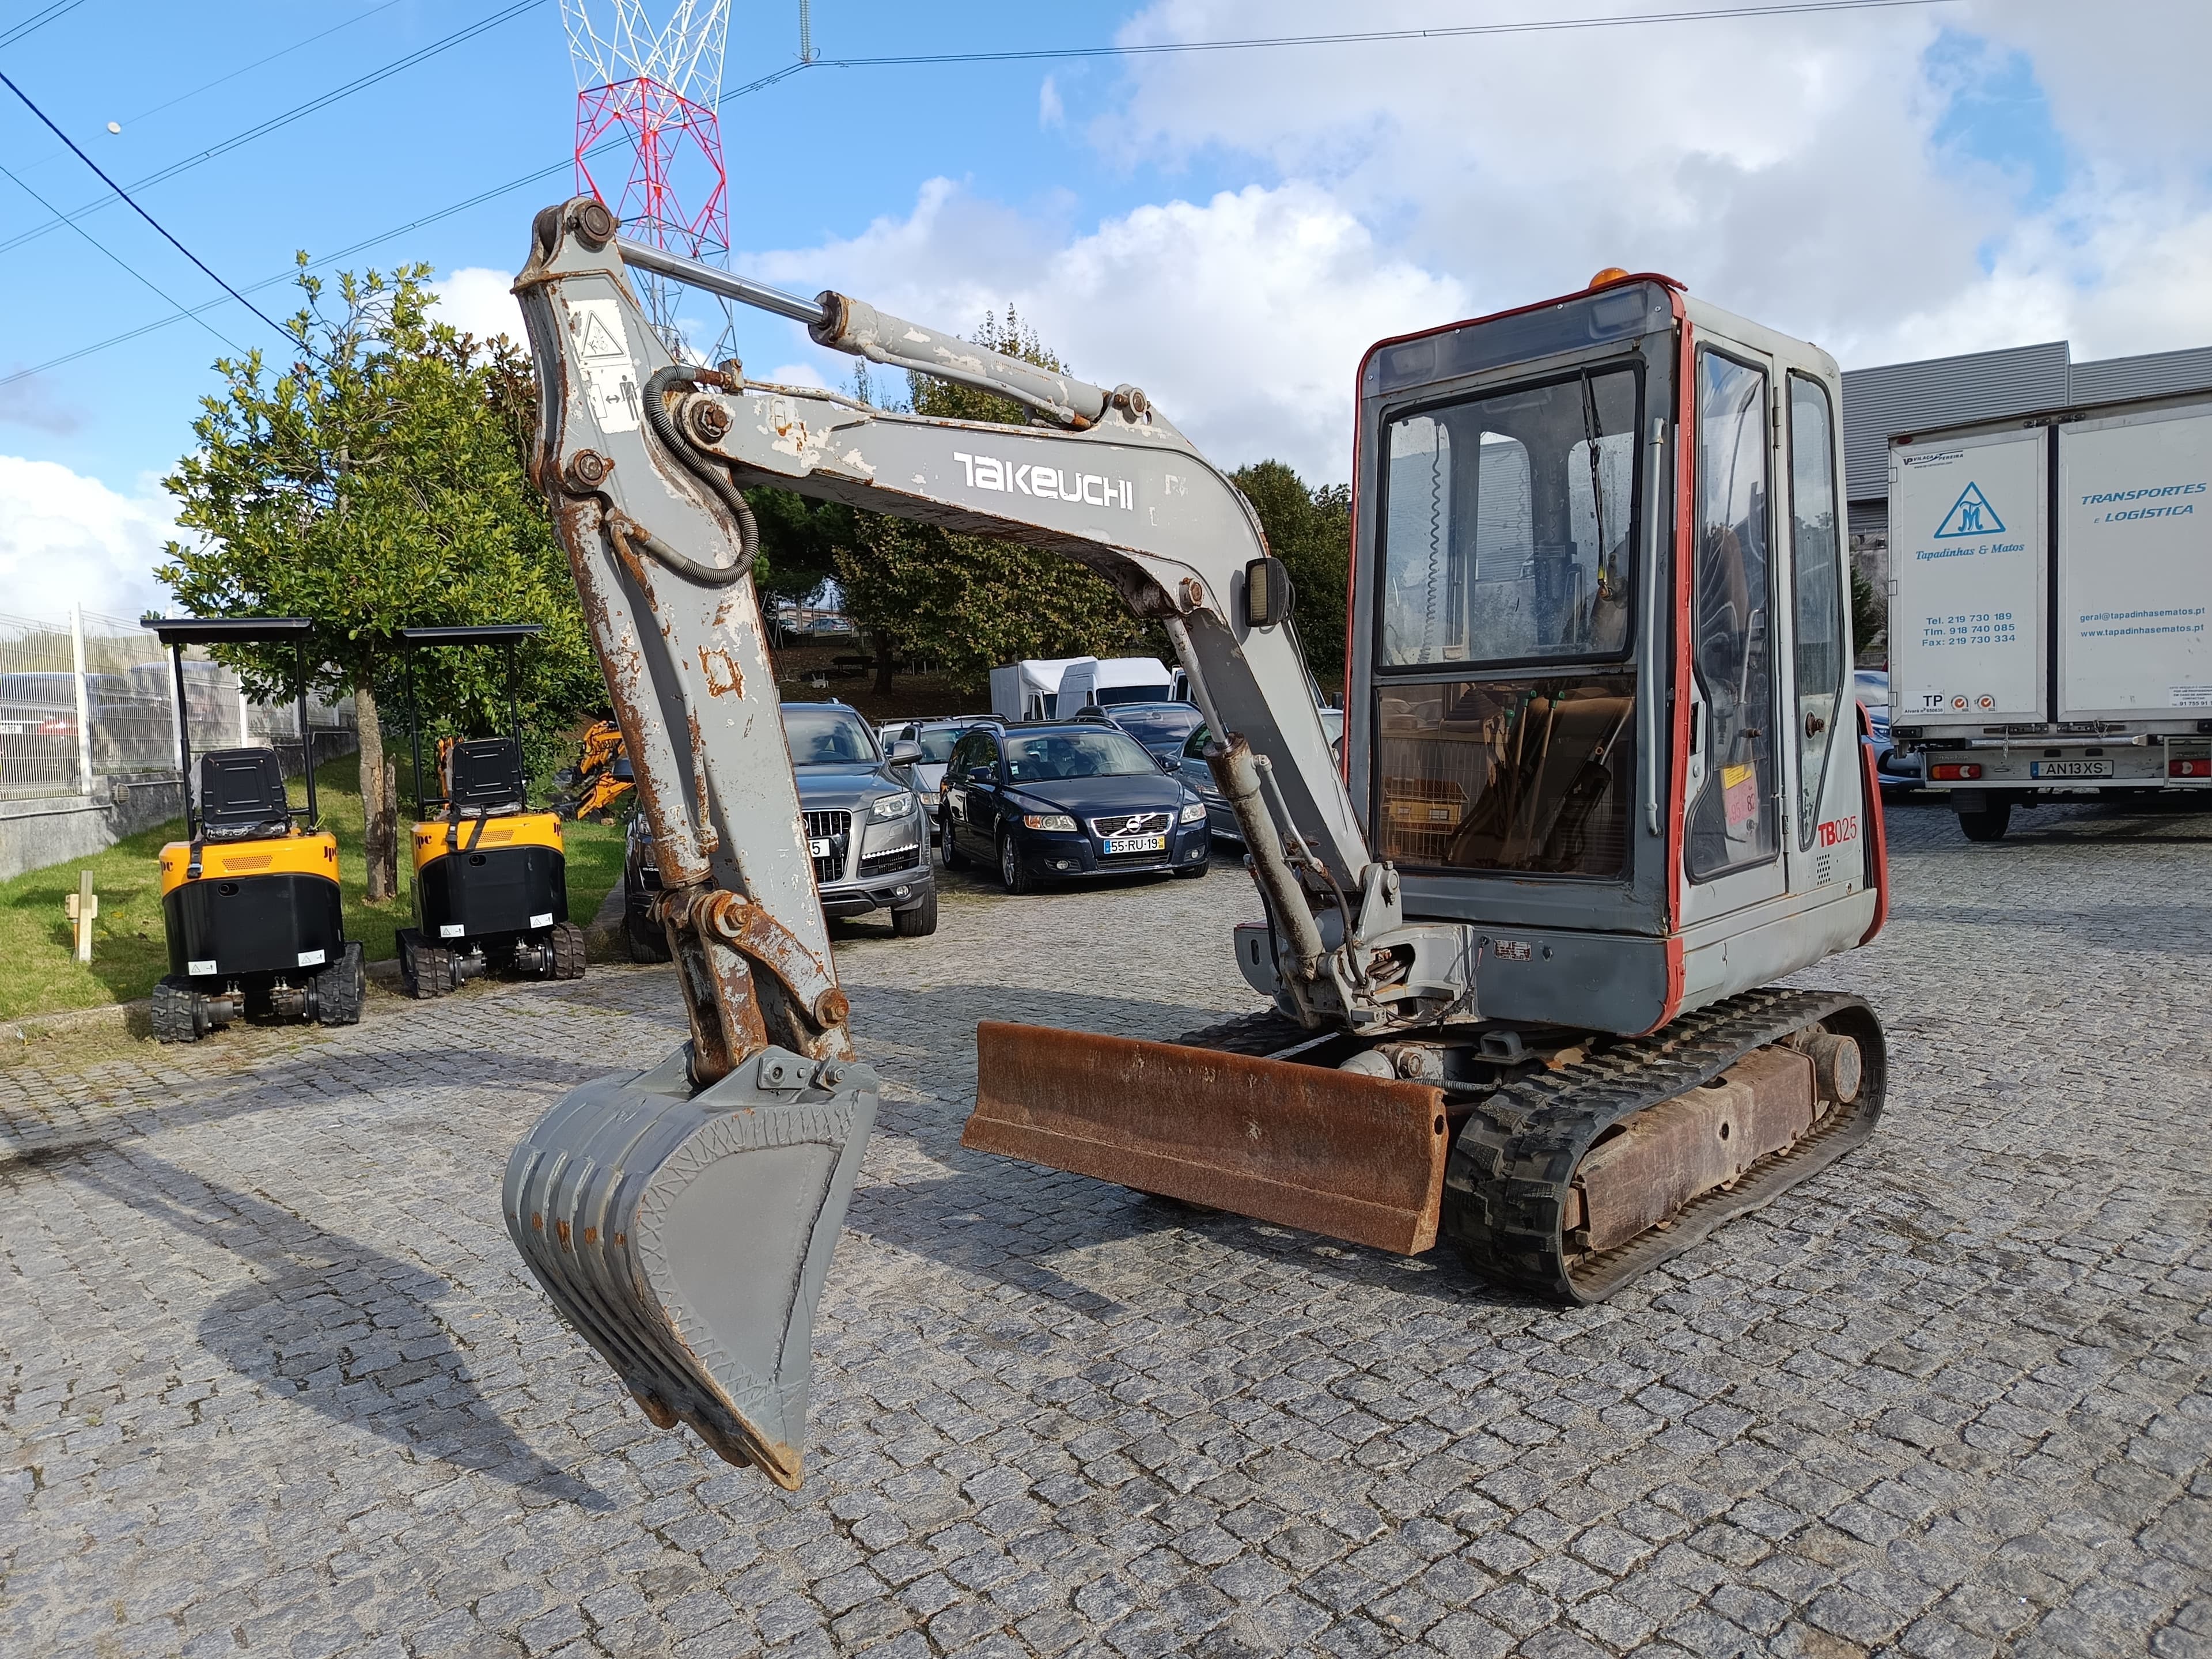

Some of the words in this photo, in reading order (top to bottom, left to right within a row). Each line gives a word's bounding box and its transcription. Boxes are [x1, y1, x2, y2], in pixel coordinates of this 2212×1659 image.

[2081, 483, 2207, 505] TRANSPORTES
[1915, 547, 1975, 561] Tapadinhas
[1978, 545, 1989, 555] &
[1991, 543, 2025, 554] Matos
[1926, 617, 1944, 625] Tel.
[1948, 616, 1965, 624] 219
[1969, 613, 1990, 622] 730
[1994, 612, 2012, 620] 189
[2080, 607, 2206, 623] geral@tapadinhasematos.pt
[1971, 625, 1990, 633] 740
[1994, 624, 2015, 632] 085
[2080, 624, 2205, 637] www.tapadinhasematos.pt
[1949, 637, 1967, 645] 219
[1923, 695, 1943, 707] TP
[1817, 815, 1857, 848] TB025
